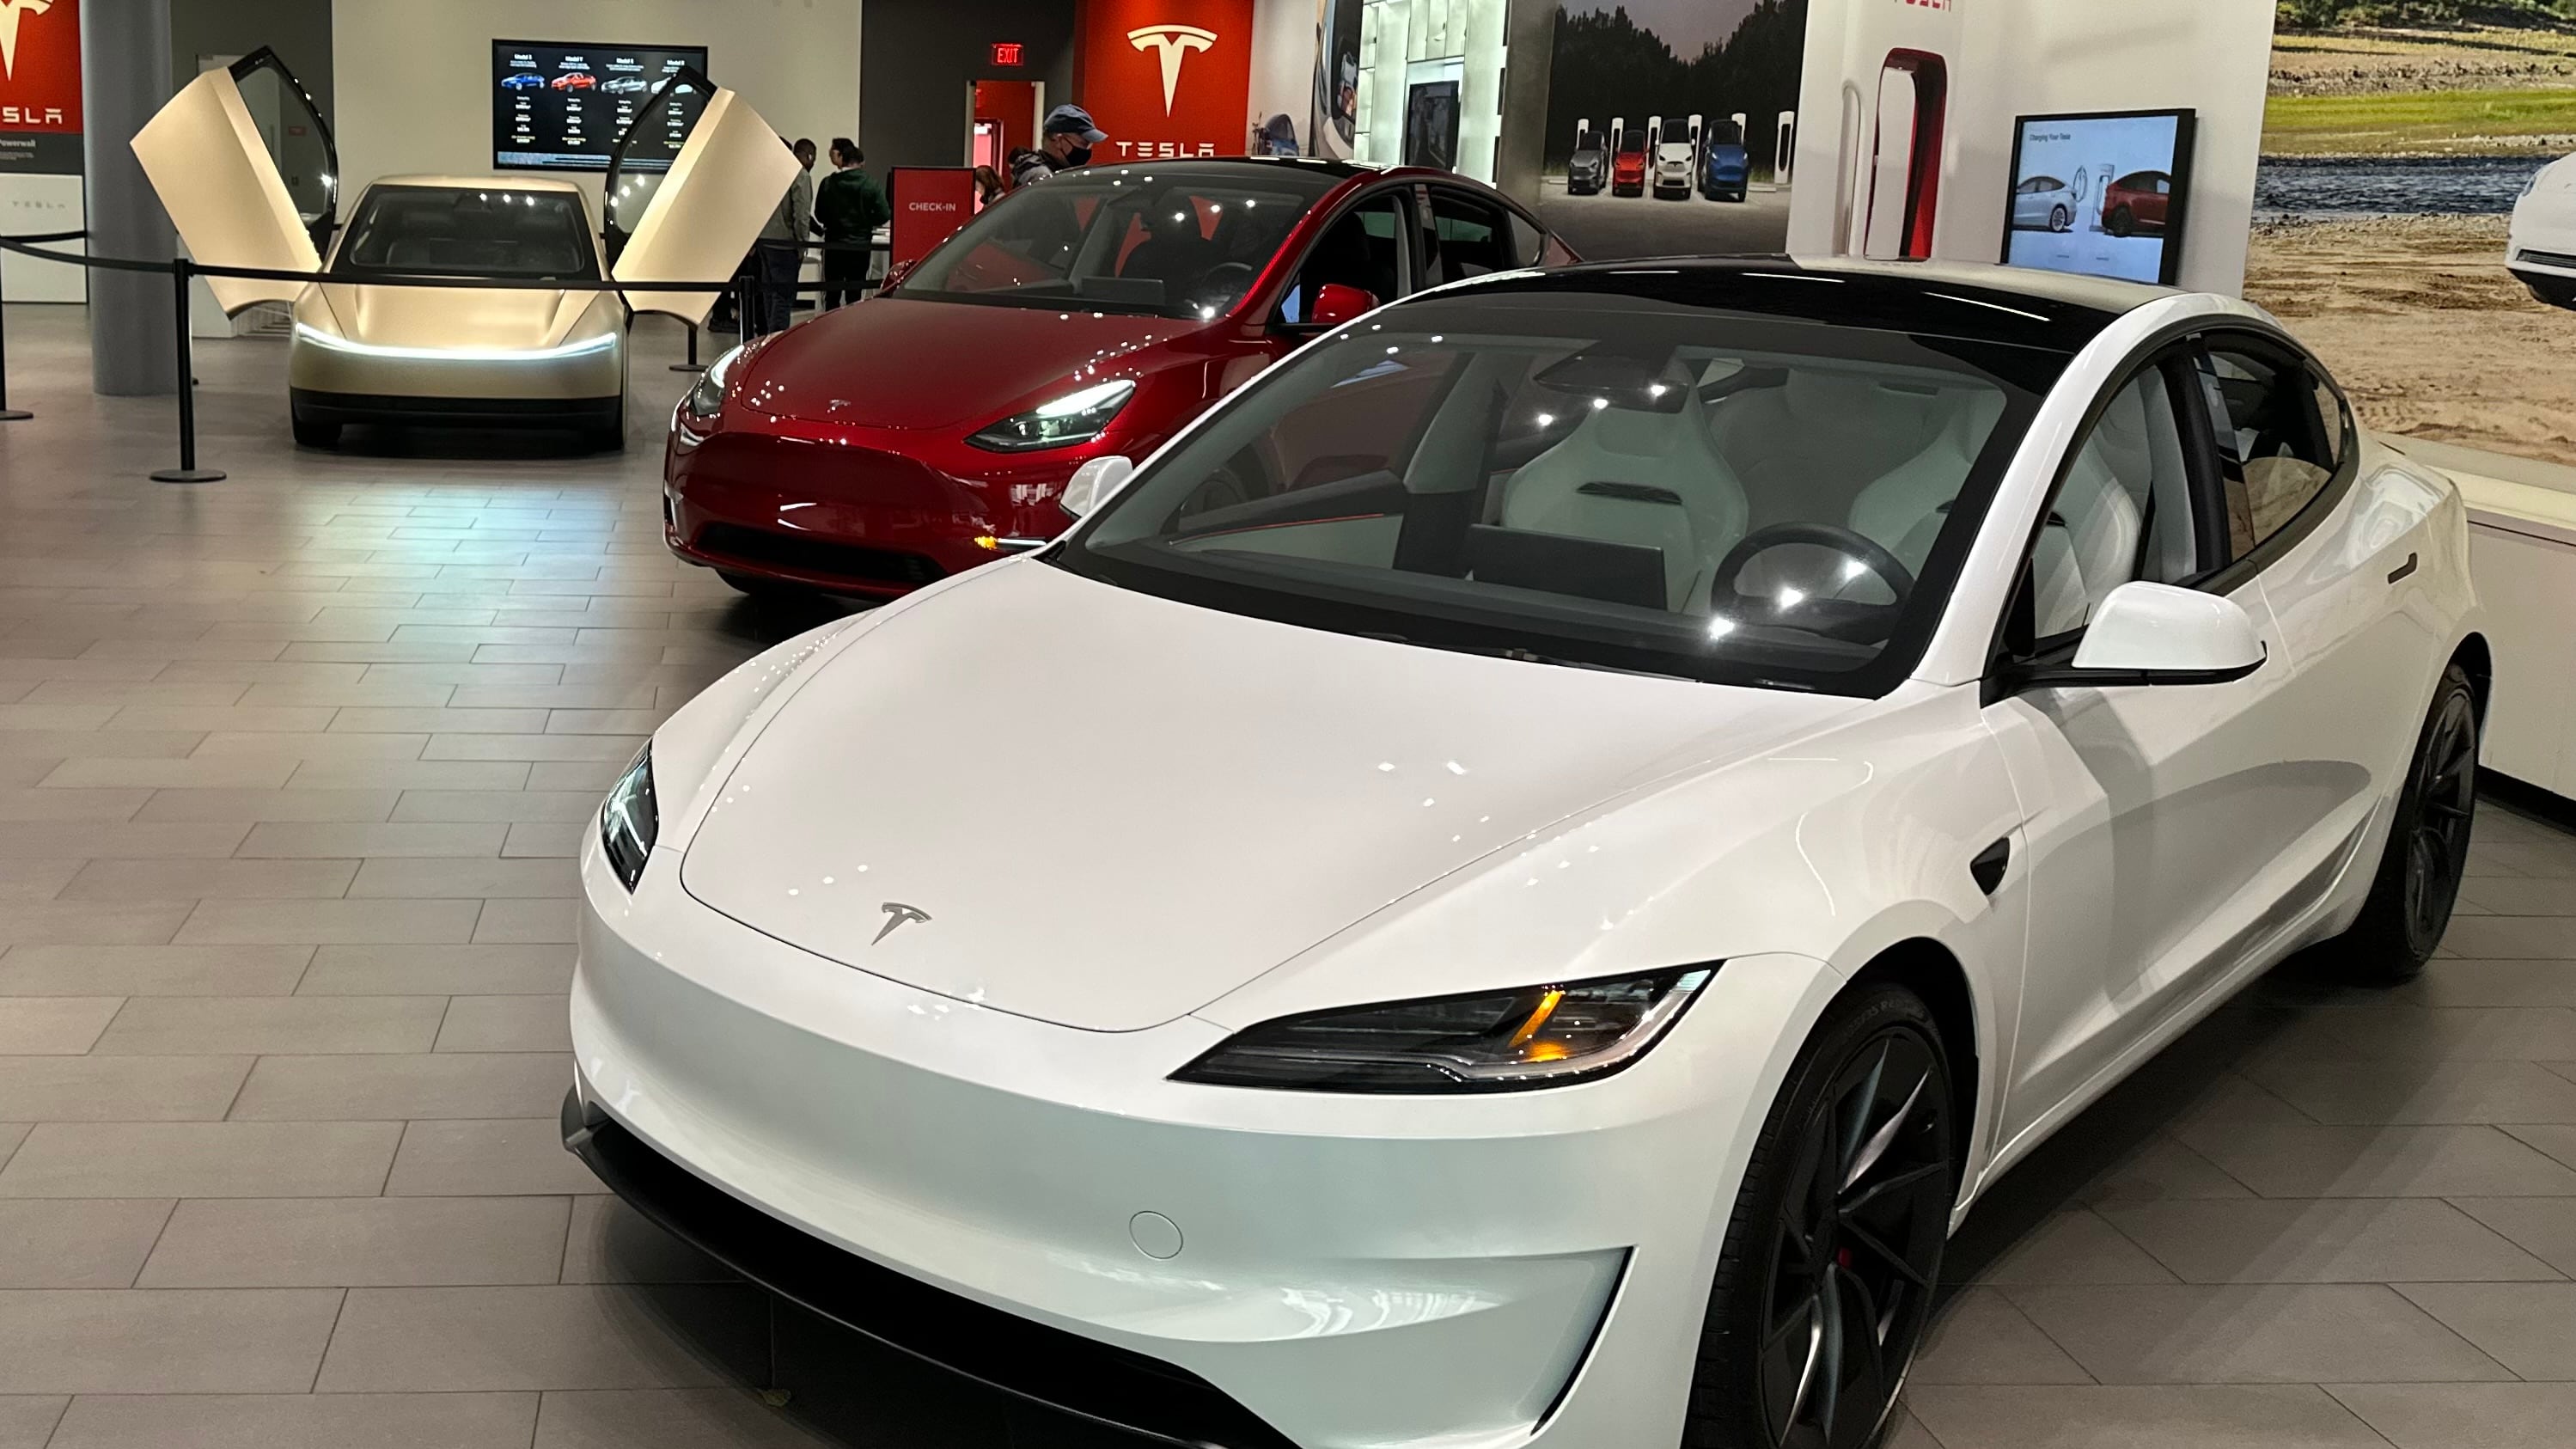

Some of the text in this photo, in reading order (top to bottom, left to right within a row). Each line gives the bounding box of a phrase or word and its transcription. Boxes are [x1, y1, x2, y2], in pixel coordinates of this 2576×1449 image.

[998, 47, 1019, 64] EXIT
[1115, 141, 1215, 158] TESLA
[908, 202, 956, 212] CHECK-IN
